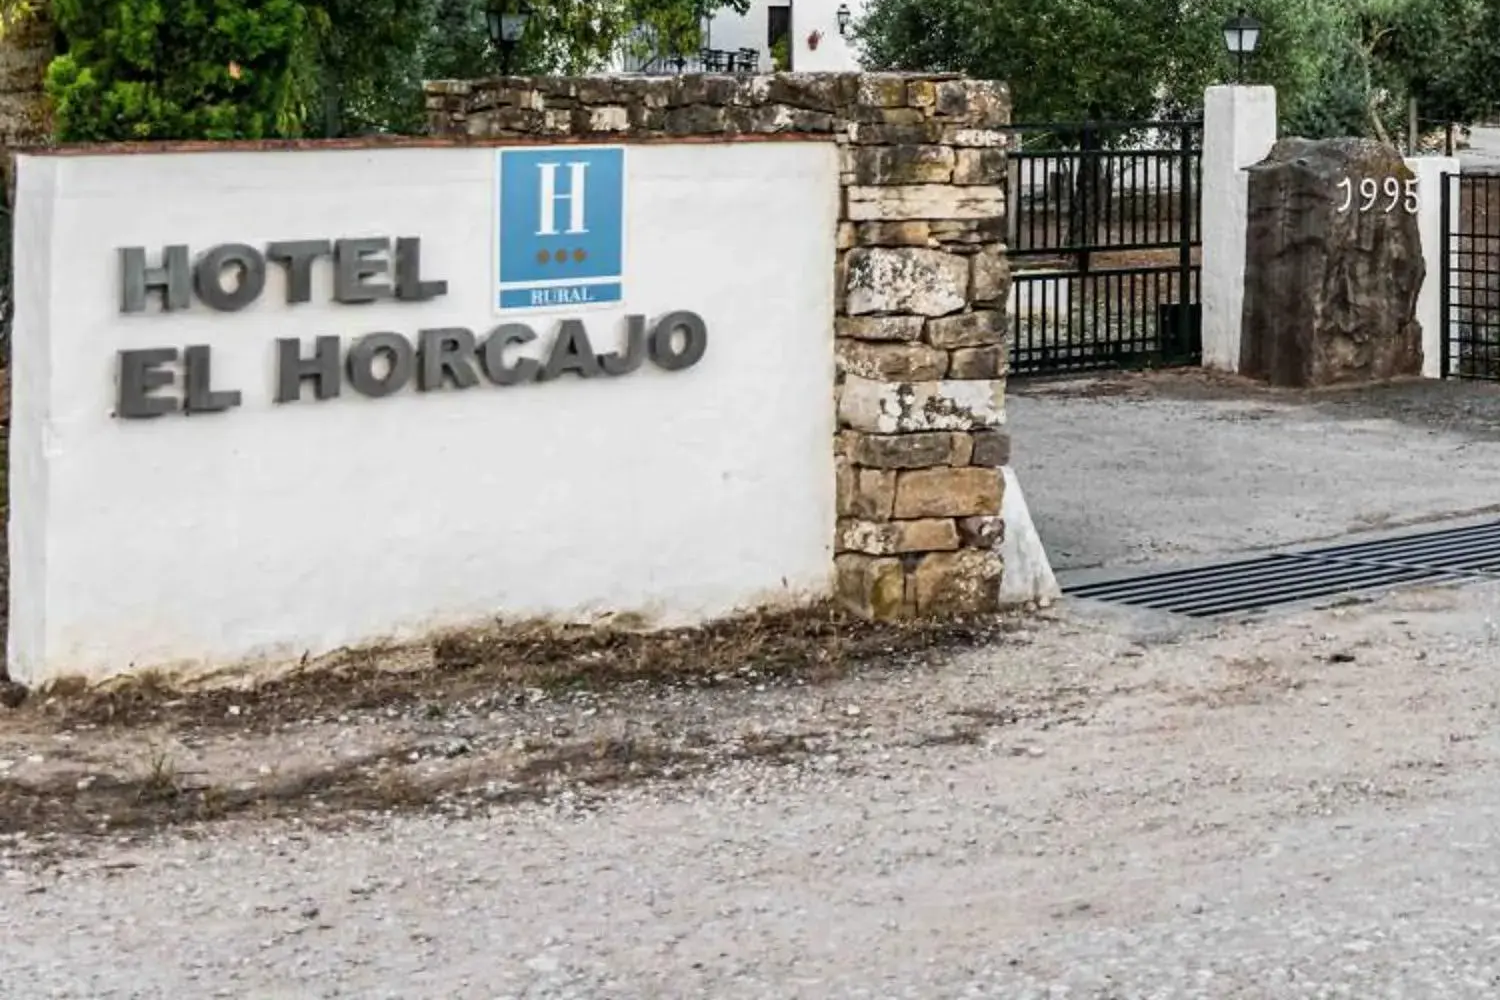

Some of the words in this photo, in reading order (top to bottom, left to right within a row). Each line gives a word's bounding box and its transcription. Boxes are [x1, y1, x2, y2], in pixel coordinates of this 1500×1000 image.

[534, 162, 591, 236] H
[1336, 176, 1419, 213] 1995
[117, 236, 448, 312] HOTEL
[531, 287, 594, 305] RURAL
[116, 345, 241, 418] EL
[273, 309, 708, 403] HORCAJO
